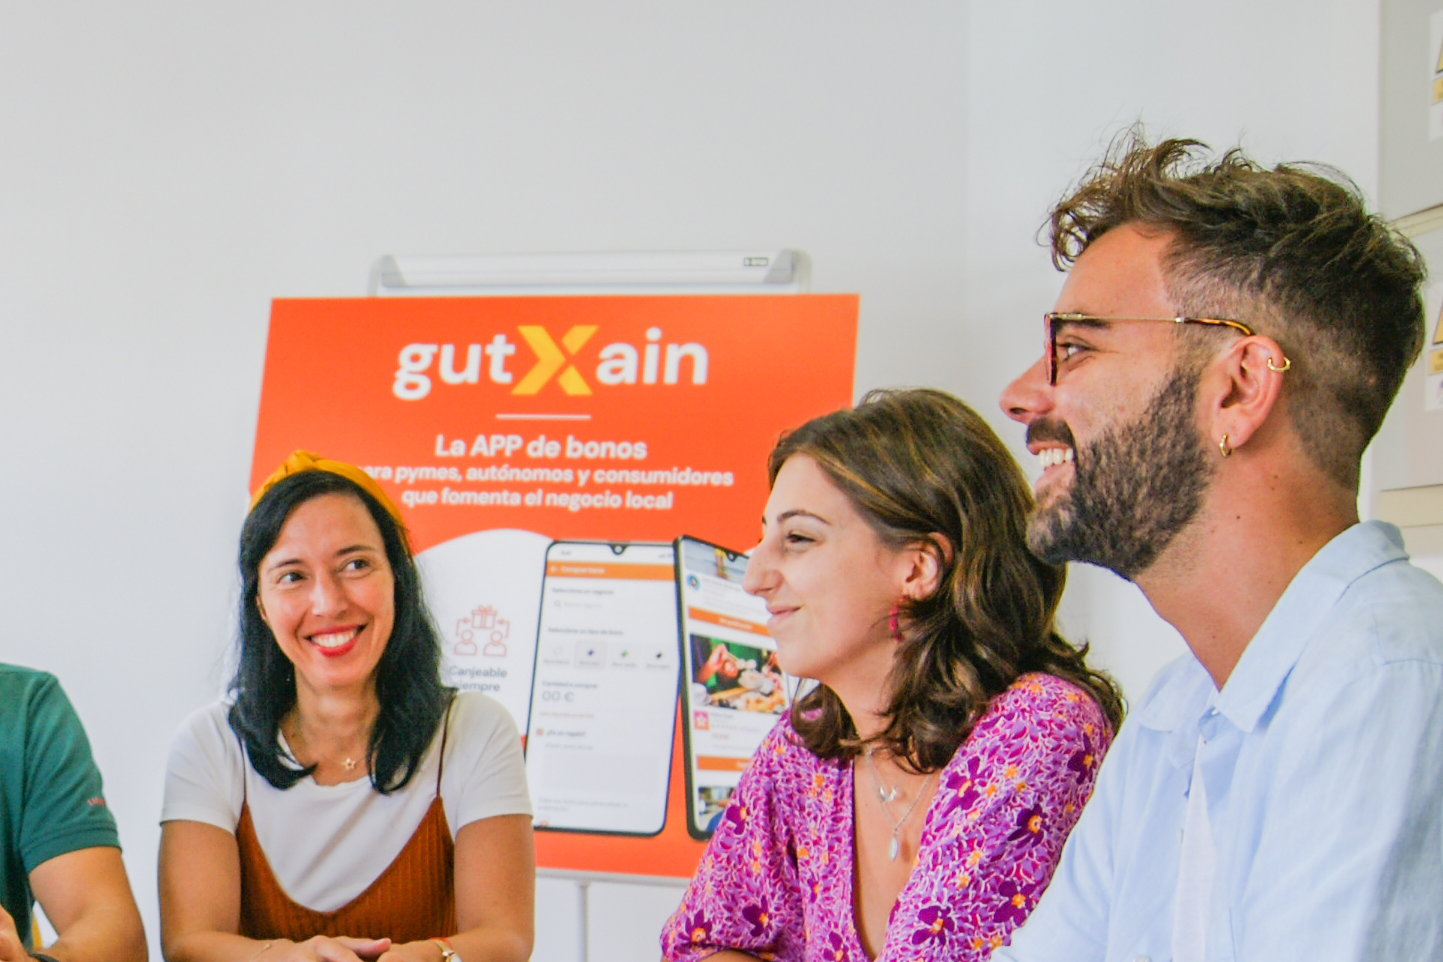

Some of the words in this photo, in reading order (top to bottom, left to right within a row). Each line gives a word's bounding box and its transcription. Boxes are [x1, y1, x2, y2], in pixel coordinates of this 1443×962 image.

[392, 325, 709, 401] gutXain
[434, 433, 466, 458] La
[469, 433, 524, 458] APP
[526, 433, 561, 459] de
[564, 434, 648, 460] bonos
[362, 466, 393, 480] ara
[394, 465, 463, 484] pymes,
[465, 463, 574, 483] autónomos
[577, 468, 591, 487] y
[592, 466, 735, 487] consumidores
[401, 489, 439, 509] que
[440, 486, 523, 507] fomenta
[524, 488, 544, 506] el
[544, 489, 623, 513] negocio
[624, 490, 674, 510] local
[449, 666, 508, 679] Canjeable
